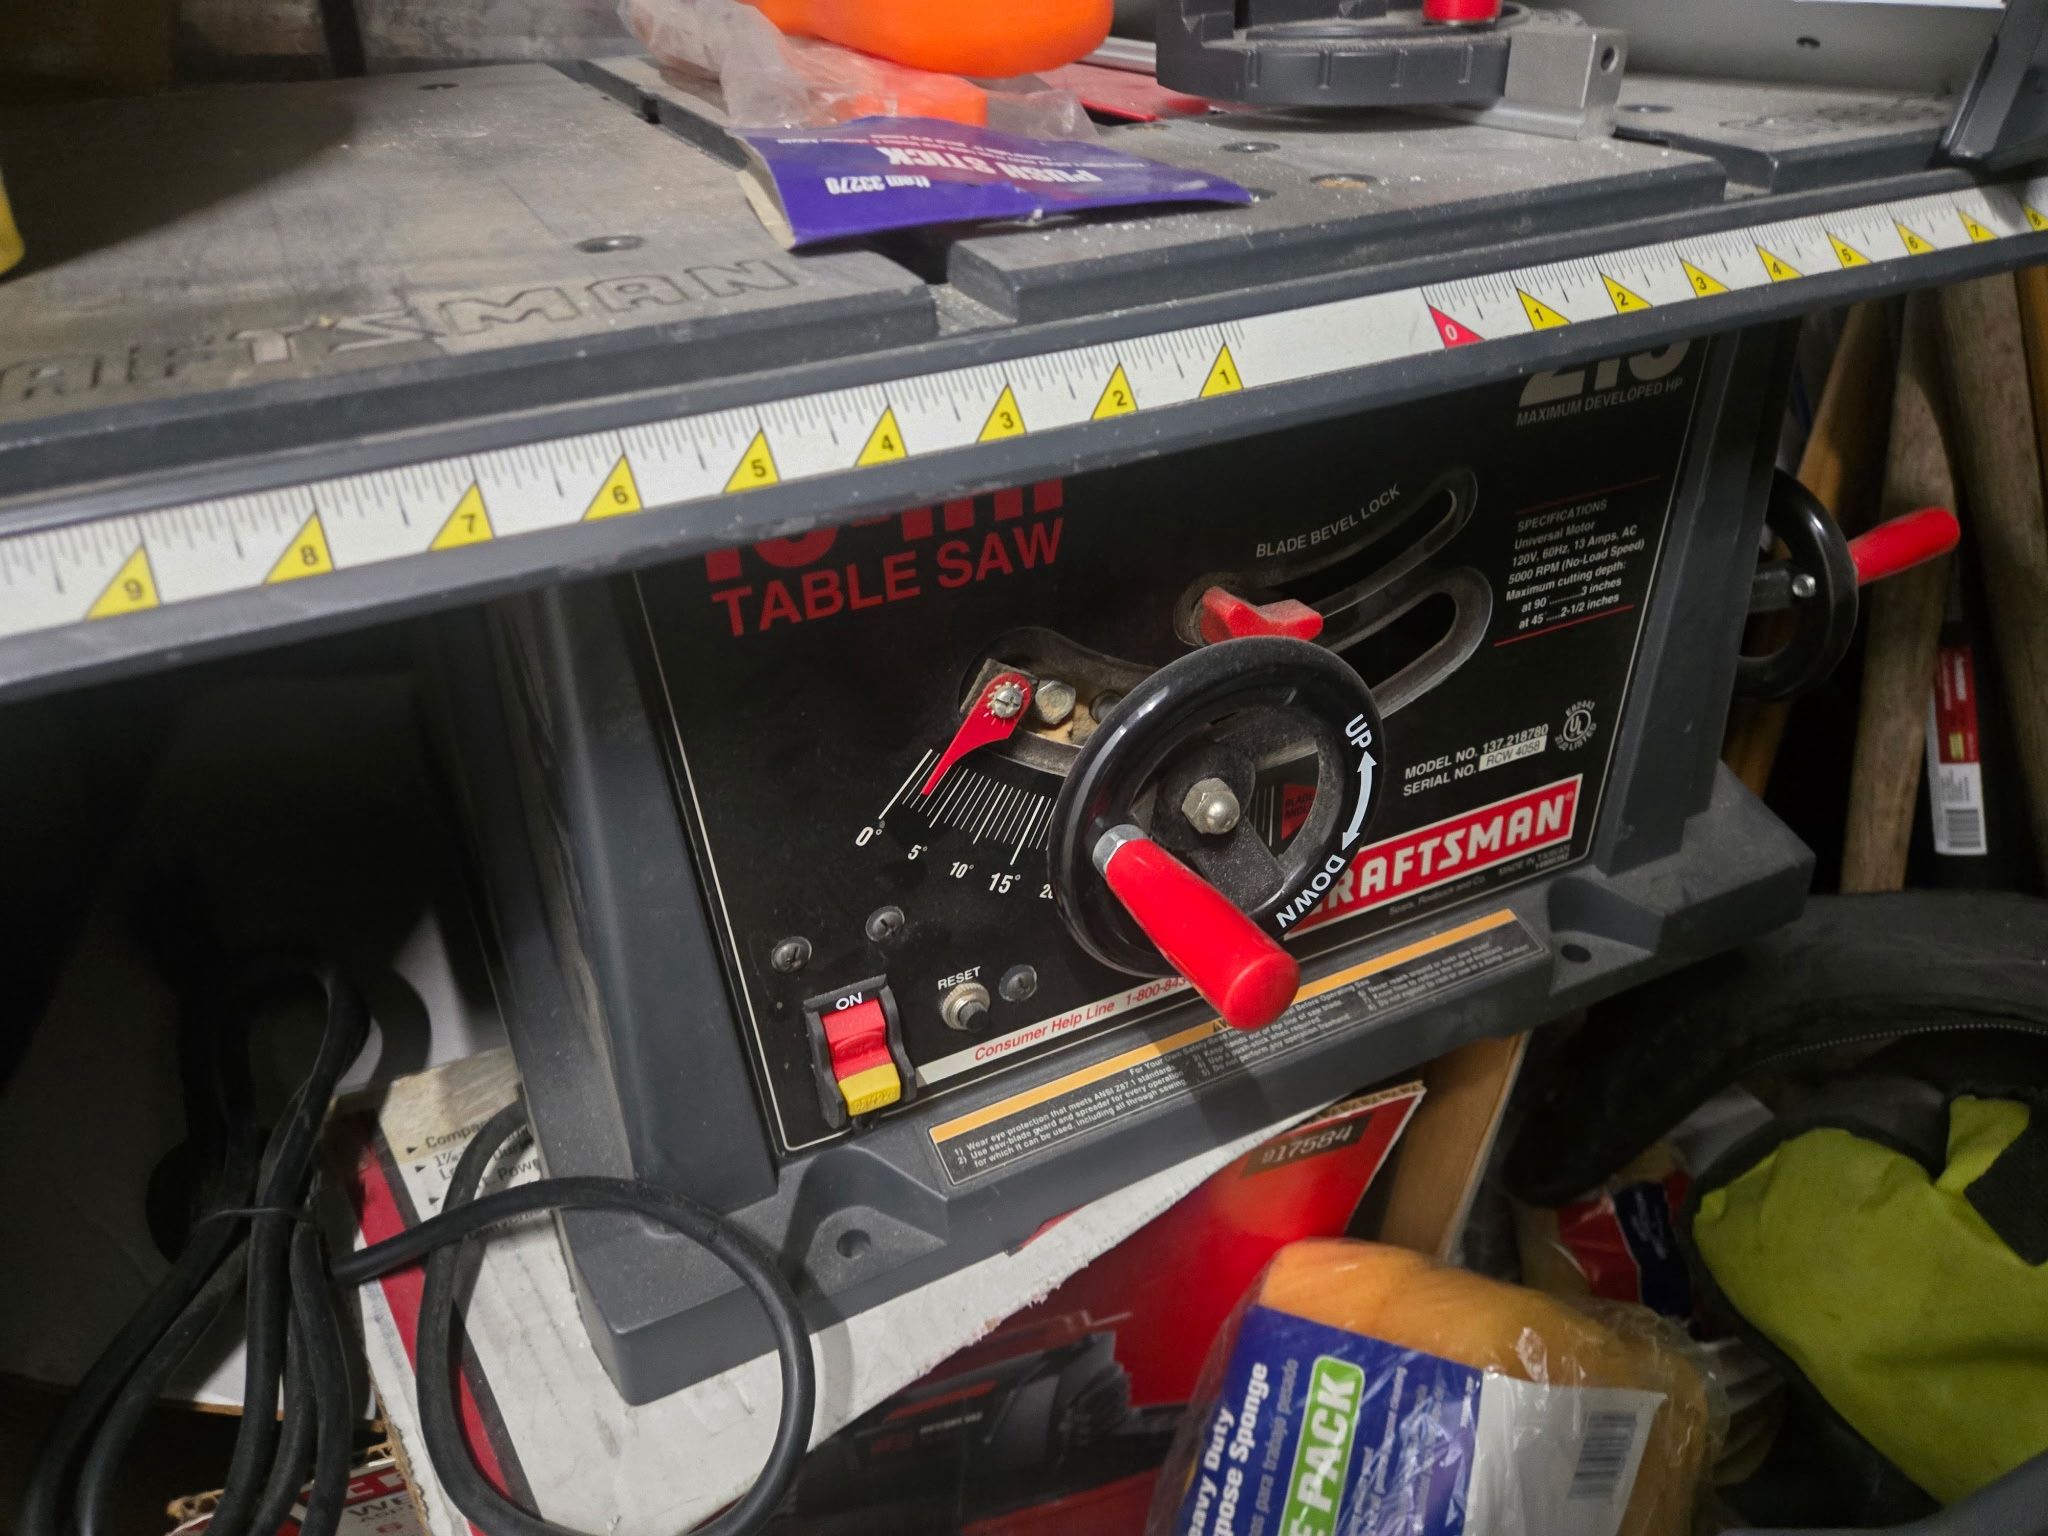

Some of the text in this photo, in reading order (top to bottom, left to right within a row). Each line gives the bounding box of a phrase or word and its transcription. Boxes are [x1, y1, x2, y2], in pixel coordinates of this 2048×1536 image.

[873, 146, 997, 175] STICK
[884, 174, 931, 188] Item
[1445, 324, 1458, 340] 0
[1534, 307, 1544, 322] 1
[1616, 292, 1629, 306] 2
[1696, 276, 1708, 291] 3
[1772, 261, 1782, 275] 4
[1842, 249, 1852, 262] 5
[1908, 236, 1918, 249] 6
[1971, 224, 1980, 237] 7
[1516, 378, 1683, 426] MAXIMUM DEVELOPED HP
[123, 370, 1231, 600] 9 8 7 6 5 4 3 2 1
[1256, 483, 1401, 558] BLADE BEVEL LOCK
[1514, 521, 1596, 550] Universal Motor
[1517, 499, 1608, 532] SPECIFICATIONS
[1574, 539, 1586, 551] 13
[1622, 524, 1638, 539] AC
[712, 551, 922, 637] TABLE
[936, 518, 1064, 590] SAW
[1505, 580, 1556, 601] Maximum
[1557, 569, 1593, 587] cutting
[1508, 538, 1646, 585] 5000 RPM (No-Load Speed)
[1518, 619, 1529, 630] at
[1586, 594, 1620, 610] inches
[1521, 602, 1532, 613] at
[1588, 577, 1622, 594] inches
[1345, 713, 1373, 749] UP
[1403, 772, 1451, 797] SERIAL
[1454, 764, 1477, 781] NO.
[1405, 756, 1452, 780] MODEL
[1455, 746, 1479, 764] NO.
[1310, 793, 1566, 914] RAFTSMAN
[1275, 854, 1347, 929] DOWN
[835, 991, 863, 1012] ON
[936, 966, 981, 991] RESET
[974, 1025, 1048, 1061] Consumer
[1051, 1011, 1083, 1033] Help
[1086, 1001, 1115, 1020] Line
[1129, 1066, 1144, 1076] For
[1145, 1058, 1164, 1071] Your
[966, 1137, 989, 1152] Wear
[991, 1131, 1006, 1142] eye
[1007, 1113, 1050, 1138] protection
[1050, 1106, 1068, 1119] that
[1068, 1096, 1093, 1111] meets
[1094, 1086, 1114, 1101] ANSI
[970, 1148, 988, 1160] Use
[989, 1130, 1032, 1153] saw-blade
[1033, 1119, 1058, 1136] guard
[1058, 1113, 1075, 1125] and
[1075, 1099, 1110, 1118] spreader
[1112, 1093, 1124, 1103] for
[1124, 1085, 1147, 1098] every
[974, 1158, 988, 1168] for
[989, 1147, 1015, 1162] which
[1023, 1137, 1040, 1149] can
[1040, 1131, 1052, 1142] be
[1076, 1107, 1116, 1128] including
[1115, 1101, 1126, 1112] all
[1126, 1090, 1158, 1108] through
[1228, 1362, 1270, 1464] Sponge
[1203, 1405, 1235, 1472] Duty
[1297, 1372, 1357, 1513] PACK
